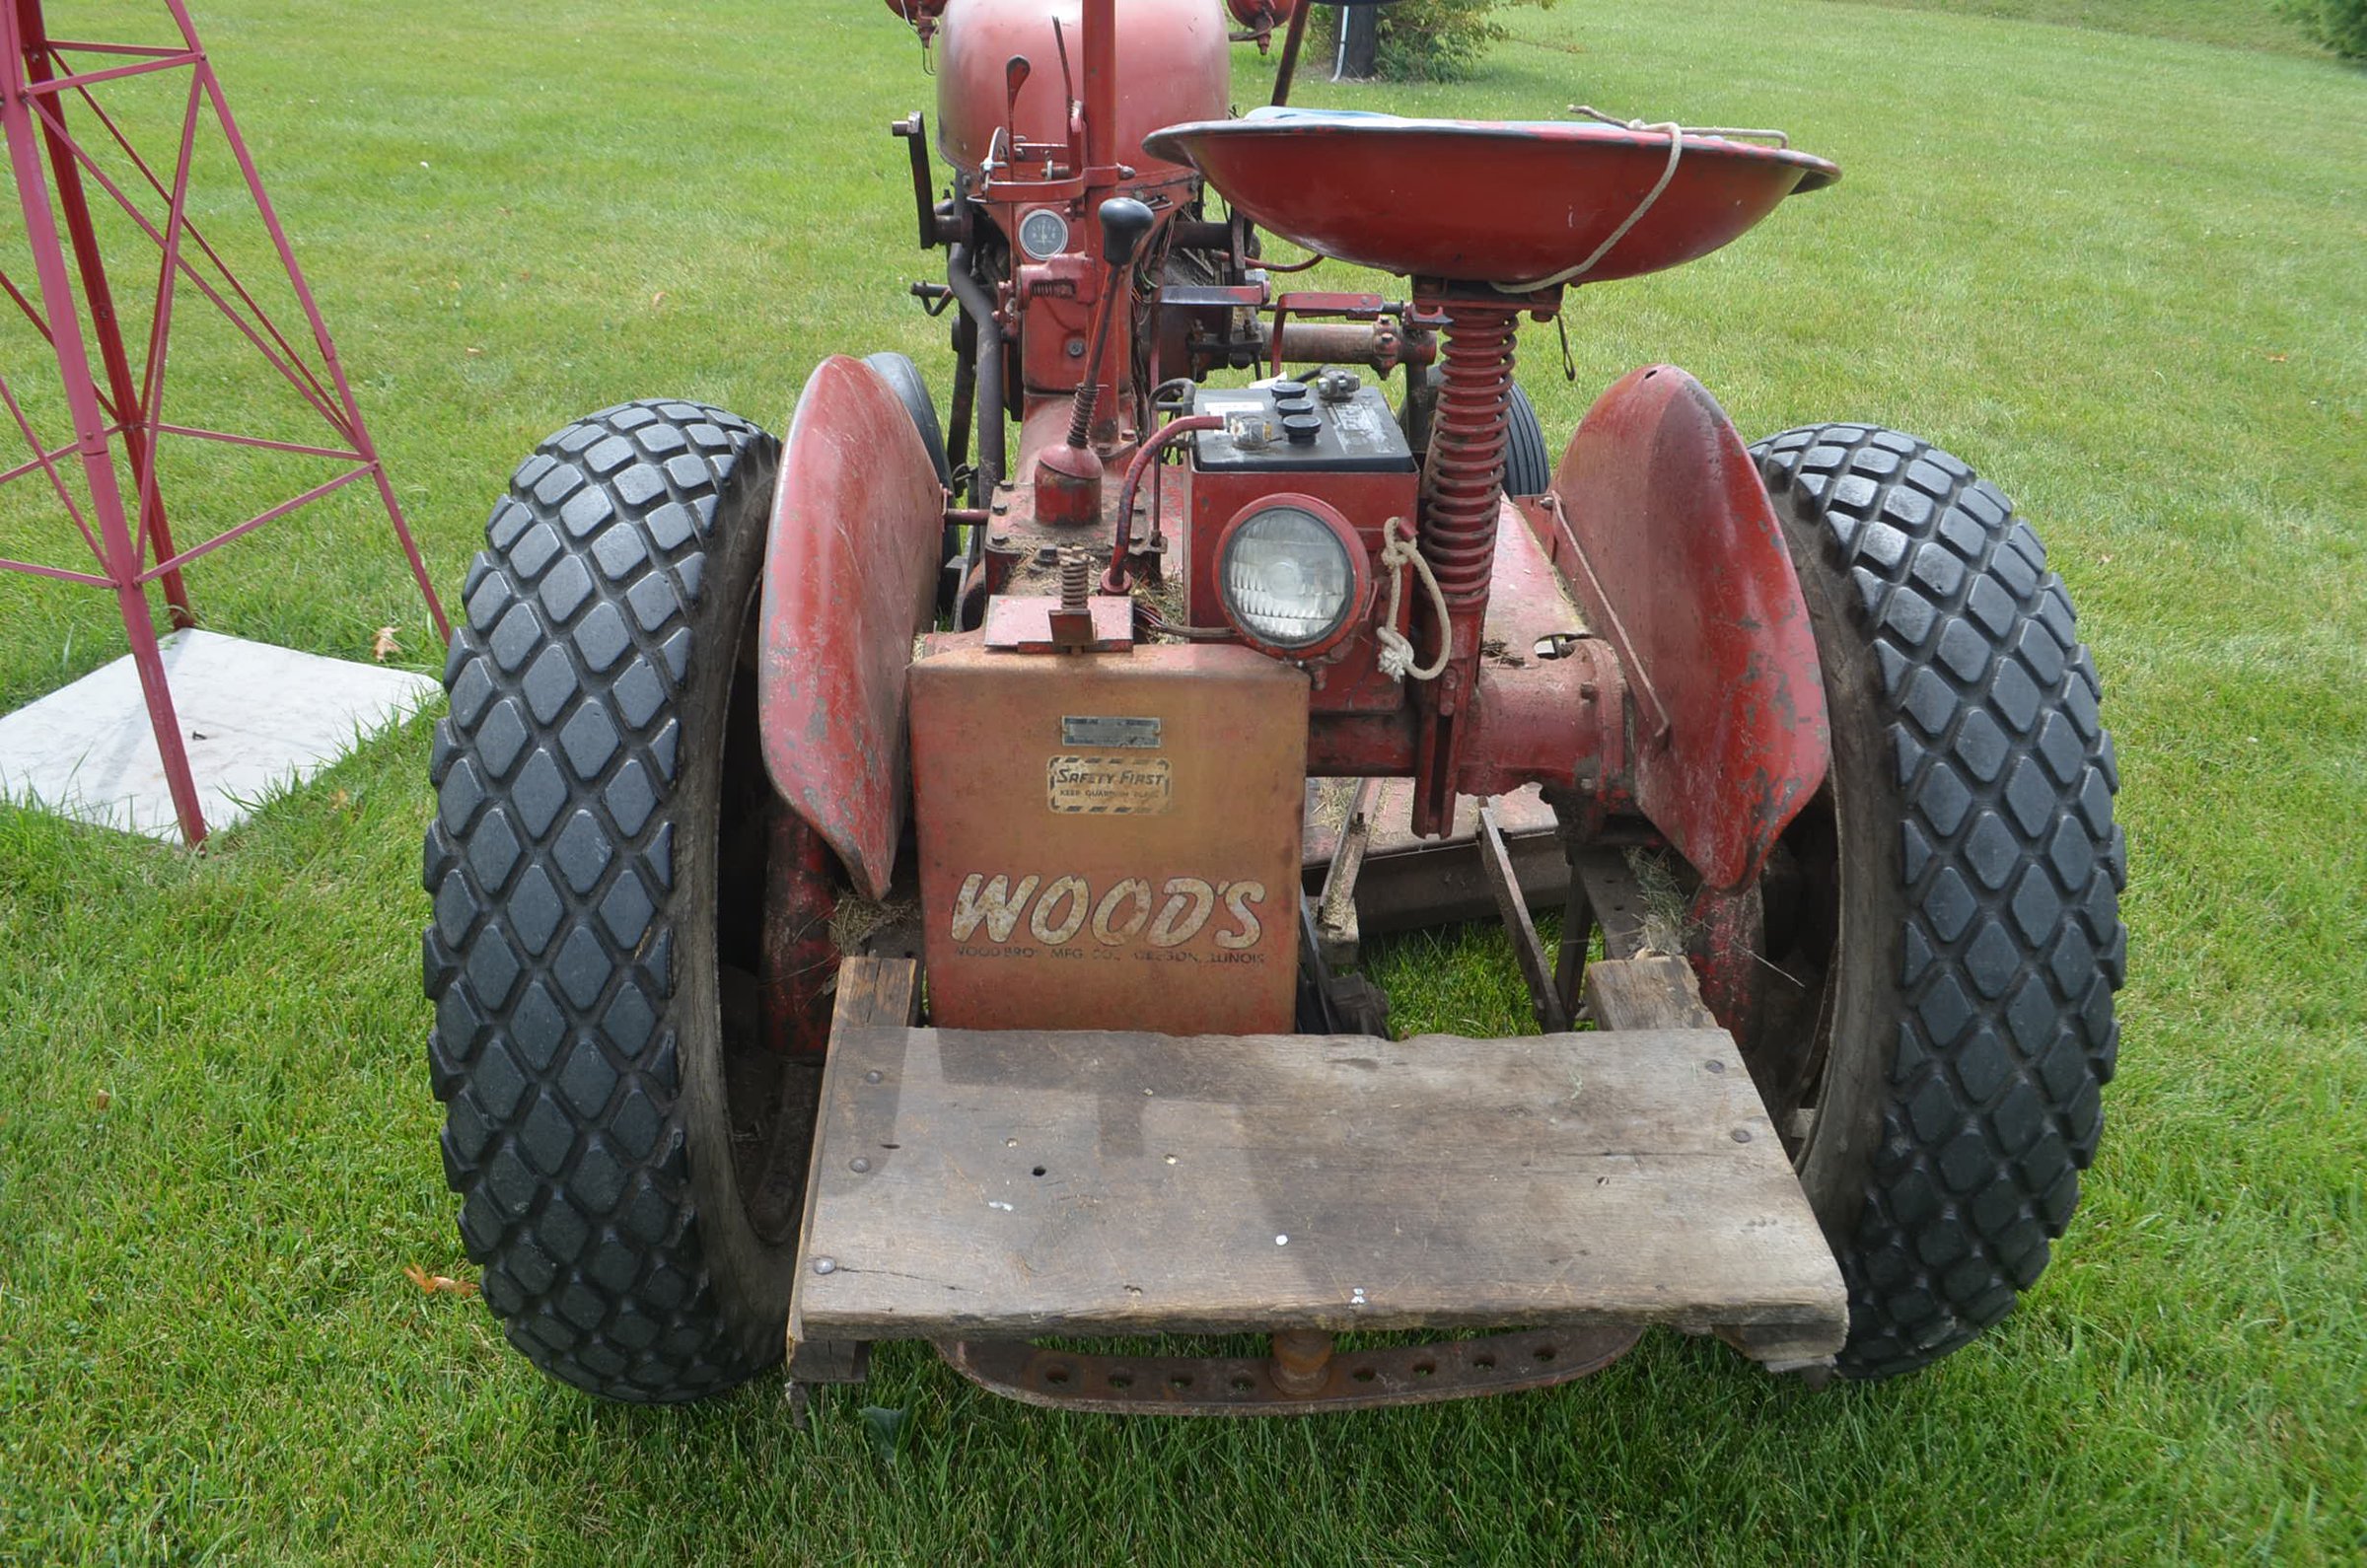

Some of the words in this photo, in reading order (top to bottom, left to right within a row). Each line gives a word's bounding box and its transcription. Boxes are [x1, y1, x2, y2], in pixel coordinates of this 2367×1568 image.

[1056, 769, 1114, 785] SAFETY
[1118, 770, 1165, 786] FIRST
[1085, 790, 1117, 799] GUARD
[951, 873, 1266, 950] WOOD'S
